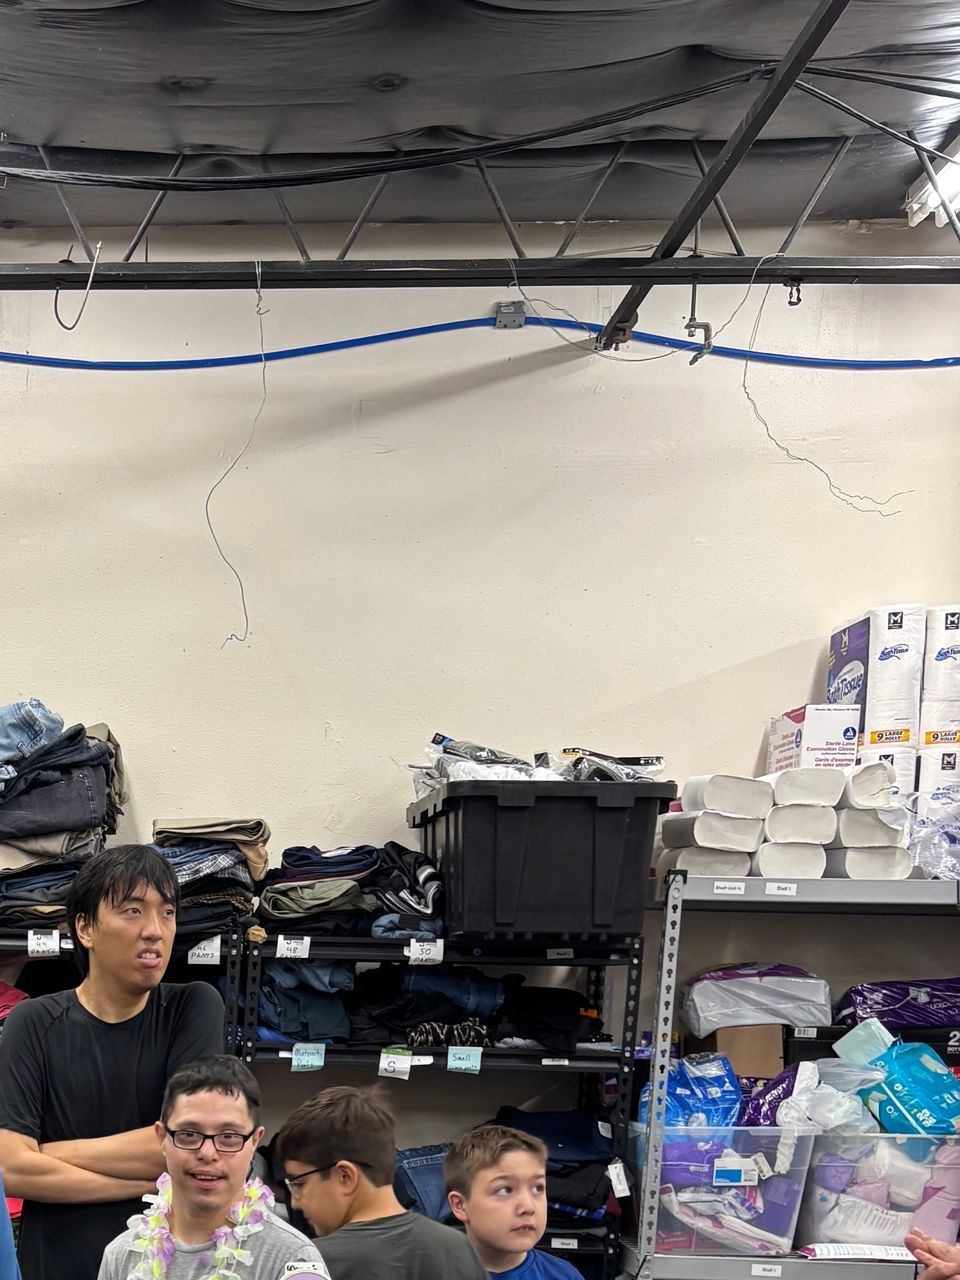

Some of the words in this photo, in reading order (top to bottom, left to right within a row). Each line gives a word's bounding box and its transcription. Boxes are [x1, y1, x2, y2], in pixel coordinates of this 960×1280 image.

[840, 673, 863, 700] Tissue
[876, 733, 884, 741] 9
[931, 733, 939, 742] 9
[420, 947, 431, 955] 50
[384, 1060, 396, 1073] S
